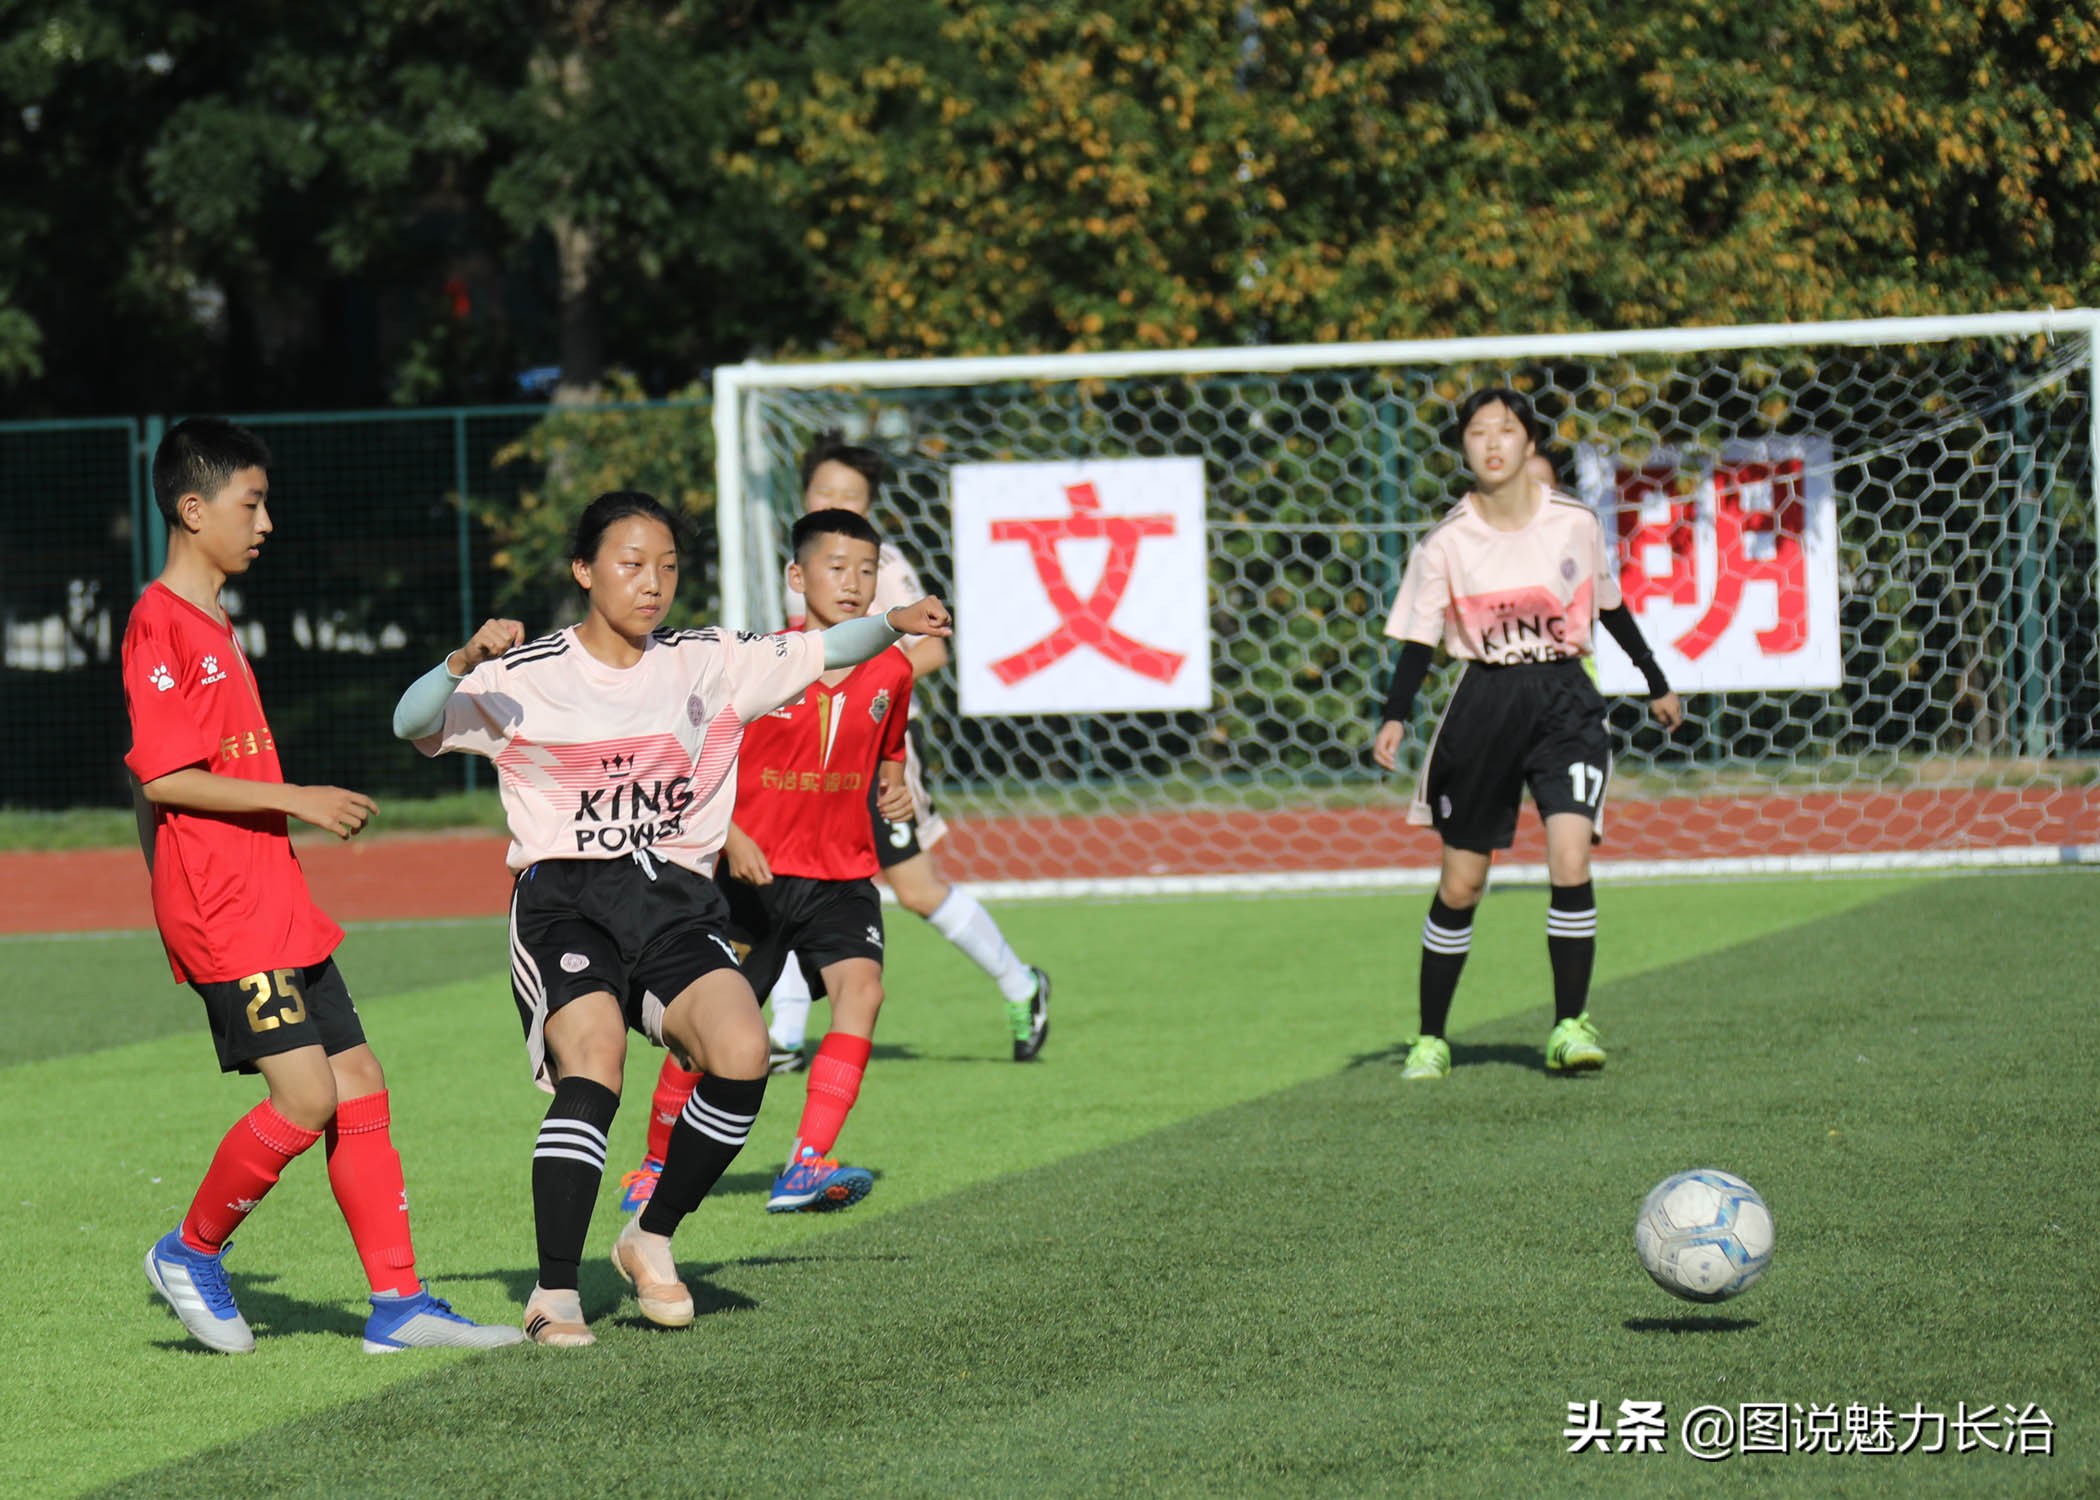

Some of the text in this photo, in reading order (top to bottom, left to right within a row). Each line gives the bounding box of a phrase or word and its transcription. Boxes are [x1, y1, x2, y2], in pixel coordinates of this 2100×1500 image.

[989, 459, 1808, 687] 文 明
[575, 776, 695, 821] KING
[1568, 762, 1603, 807] 17
[239, 968, 306, 1033] 25
